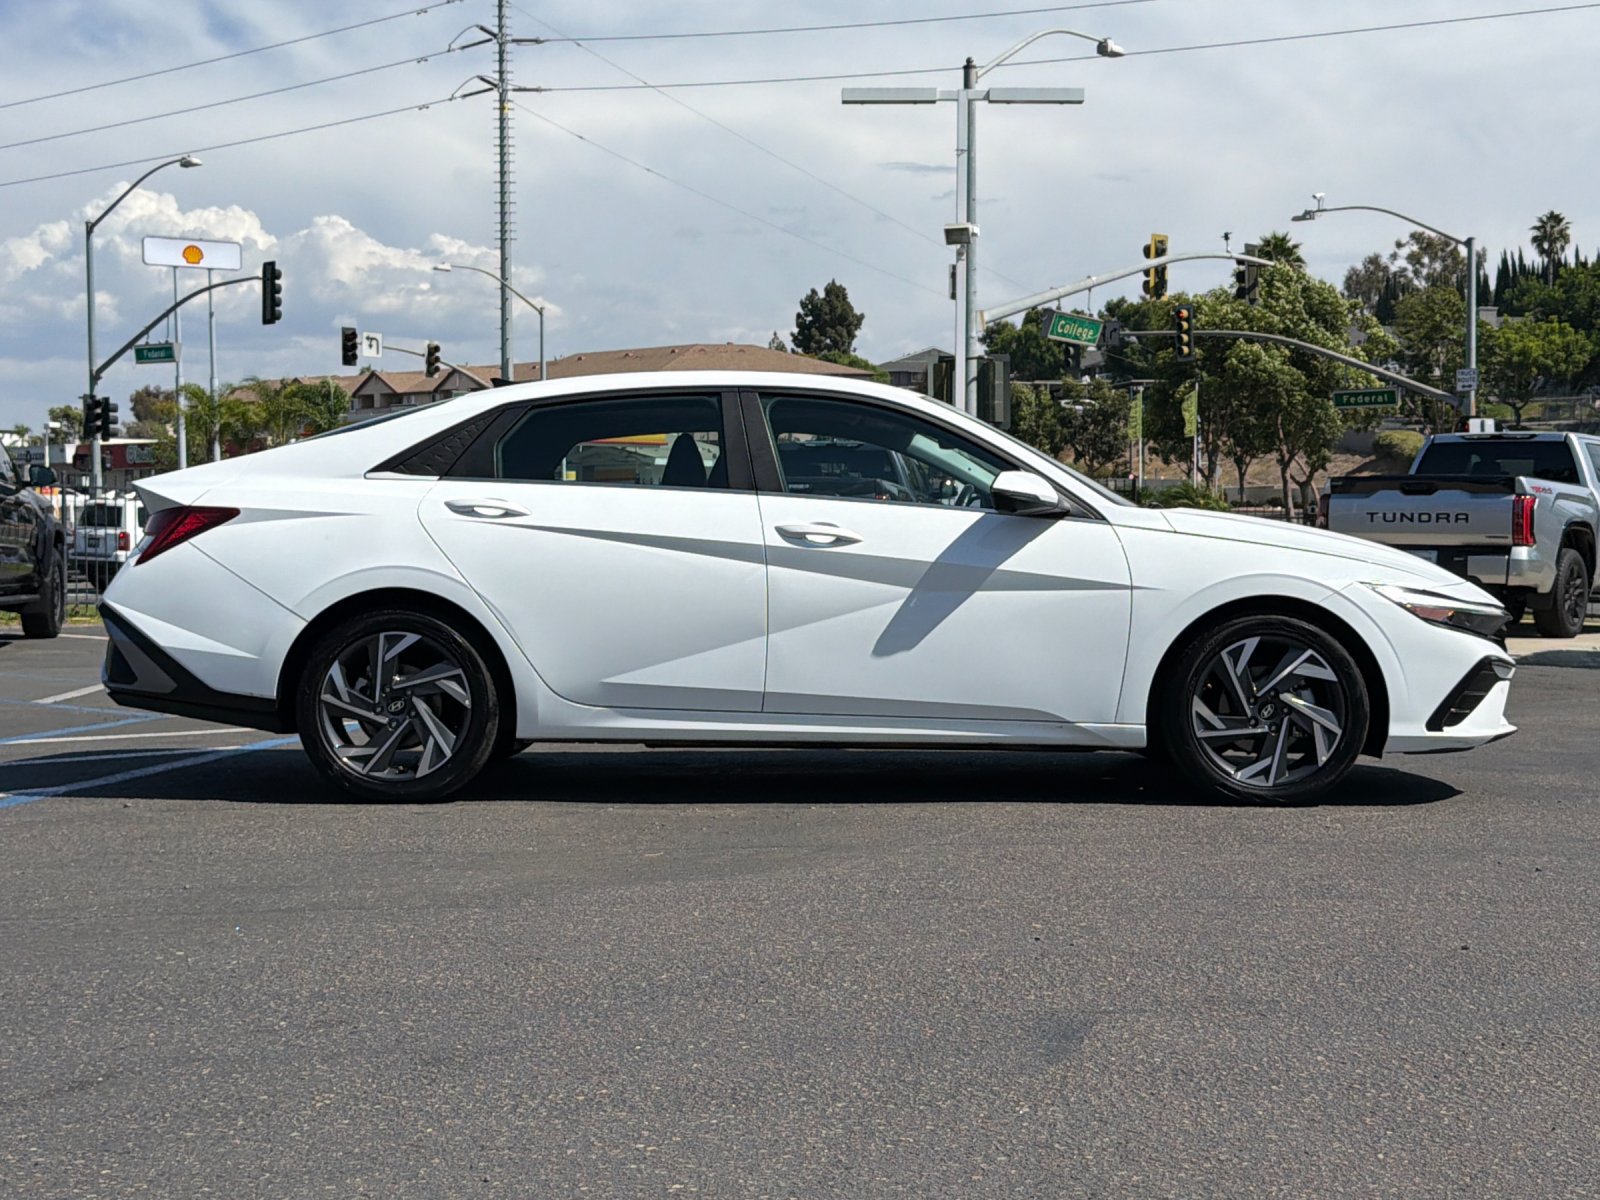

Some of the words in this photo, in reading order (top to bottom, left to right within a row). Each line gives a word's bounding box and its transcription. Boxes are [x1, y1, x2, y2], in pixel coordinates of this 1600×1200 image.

[1057, 320, 1094, 341] College
[1342, 393, 1389, 404] Federal
[1366, 511, 1470, 524] TUNDRA
